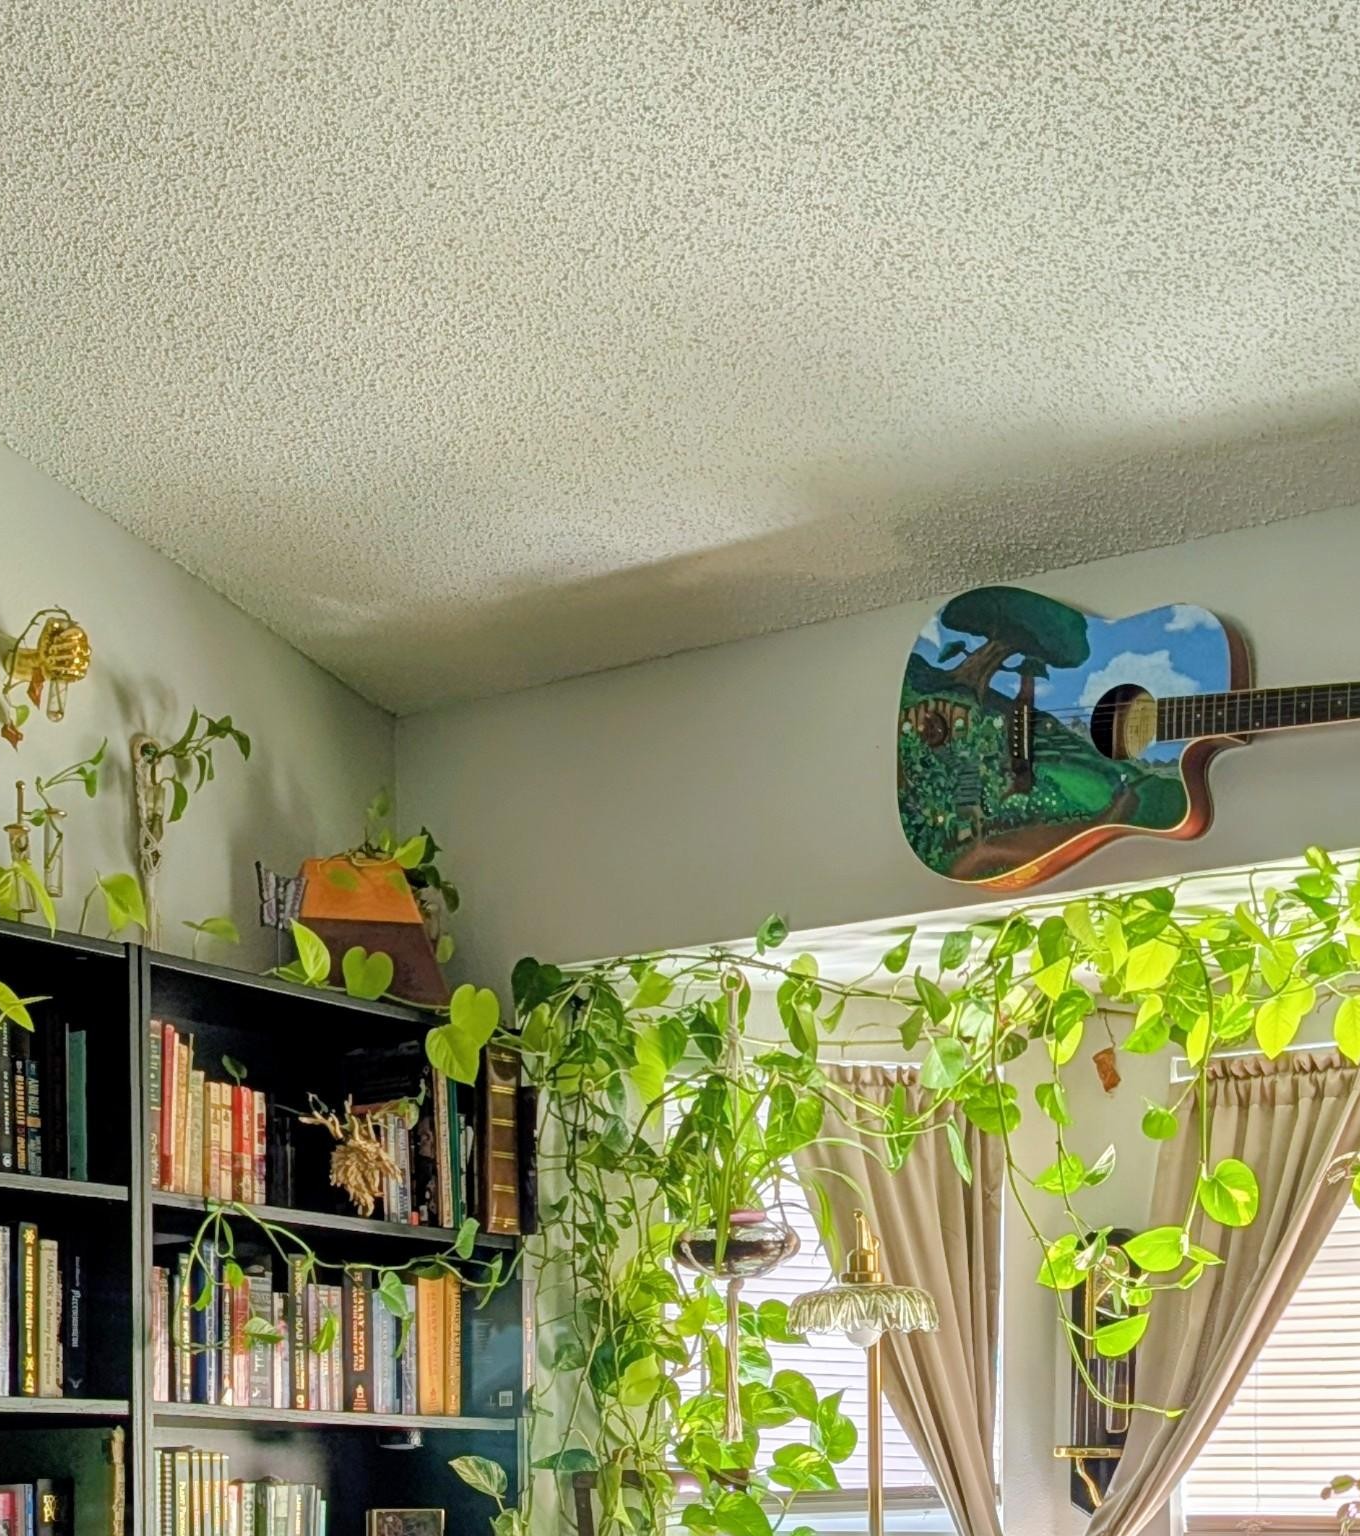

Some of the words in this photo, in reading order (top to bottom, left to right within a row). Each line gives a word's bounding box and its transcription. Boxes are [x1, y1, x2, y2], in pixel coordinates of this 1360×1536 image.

[25, 1255, 34, 1291] ALEISTER
[46, 1259, 54, 1297] MAGICK
[25, 1293, 35, 1329] CROWLEY
[357, 1286, 366, 1327] HARRY
[294, 1317, 304, 1341] DEAD
[357, 1330, 366, 1371] POTTER
